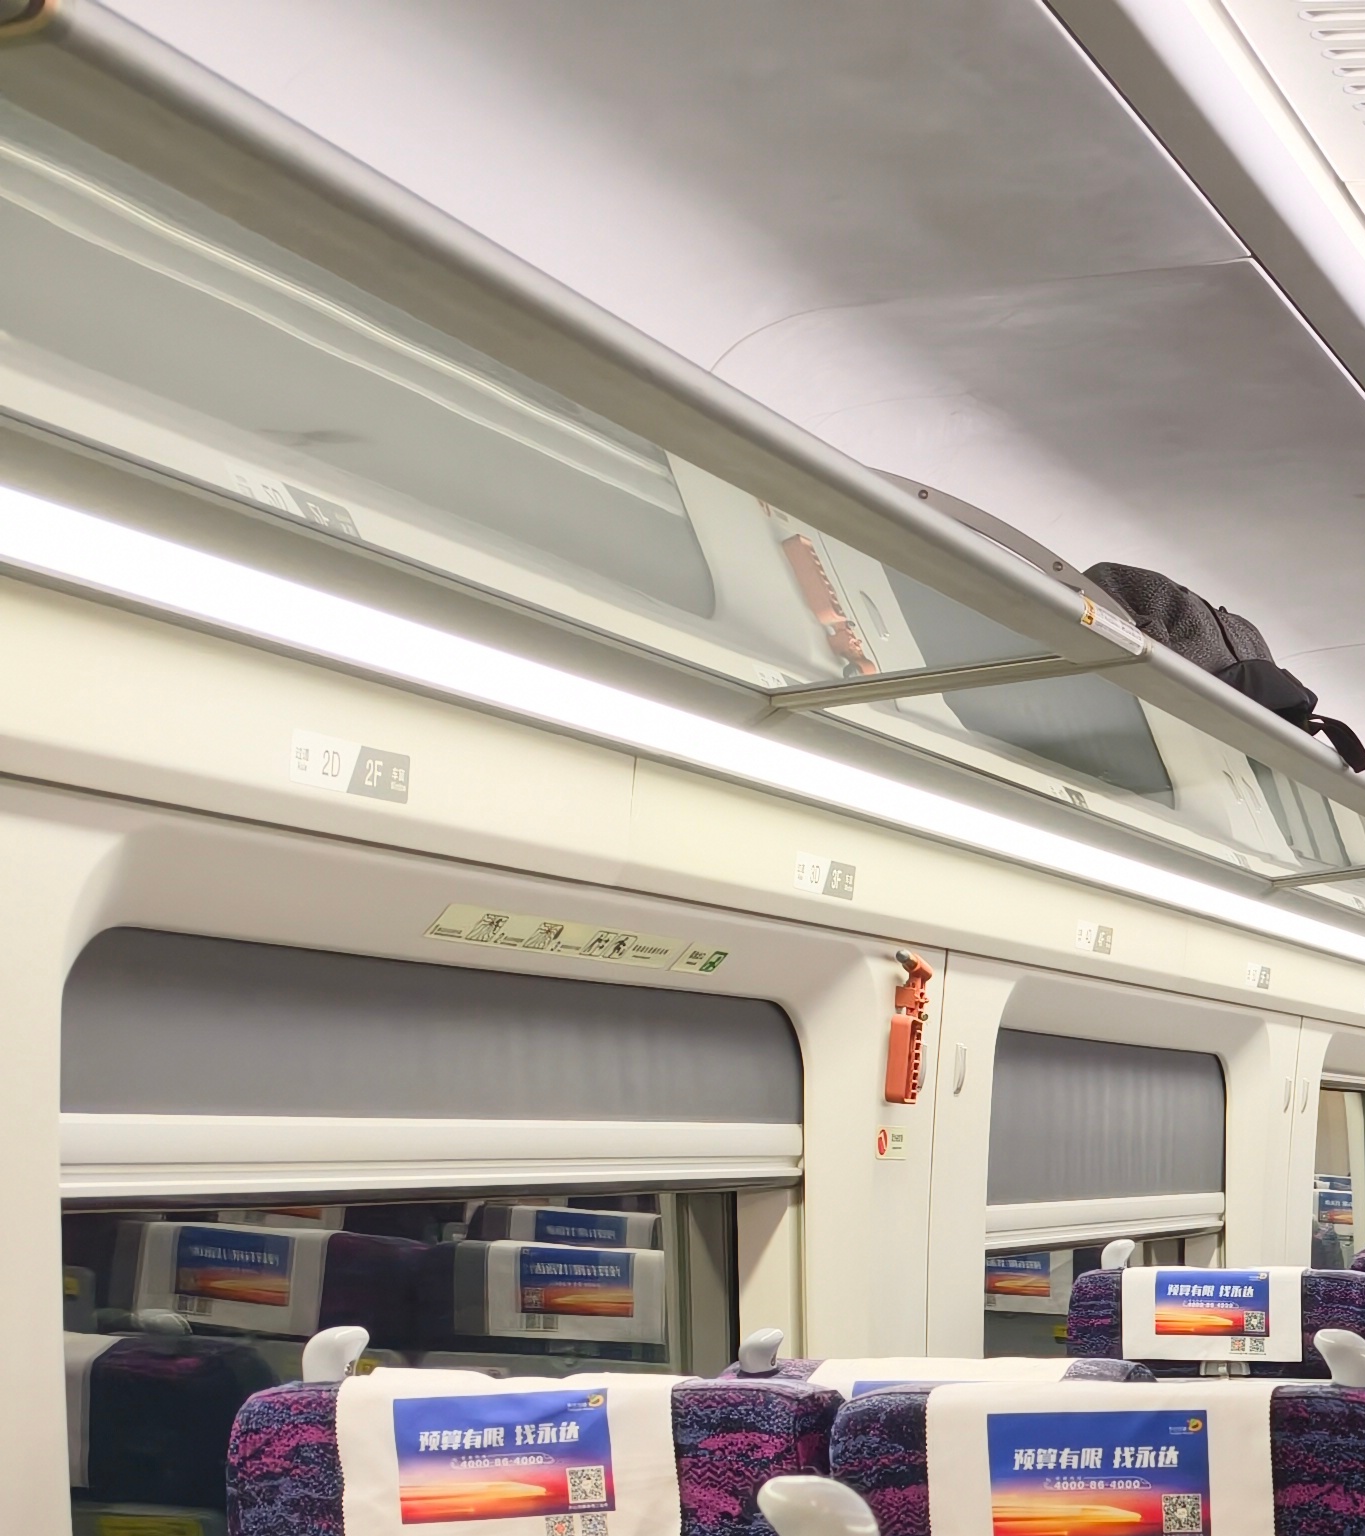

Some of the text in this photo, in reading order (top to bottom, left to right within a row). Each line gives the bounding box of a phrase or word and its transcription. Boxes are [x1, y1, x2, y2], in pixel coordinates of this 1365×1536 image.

[322, 750, 341, 777] 2D
[364, 760, 383, 787] 2F
[1167, 1284, 1254, 1297] 预算有限 找永达
[419, 1422, 579, 1452] 预算有限 找永达
[1013, 1445, 1179, 1470] 预算有限 找永达
